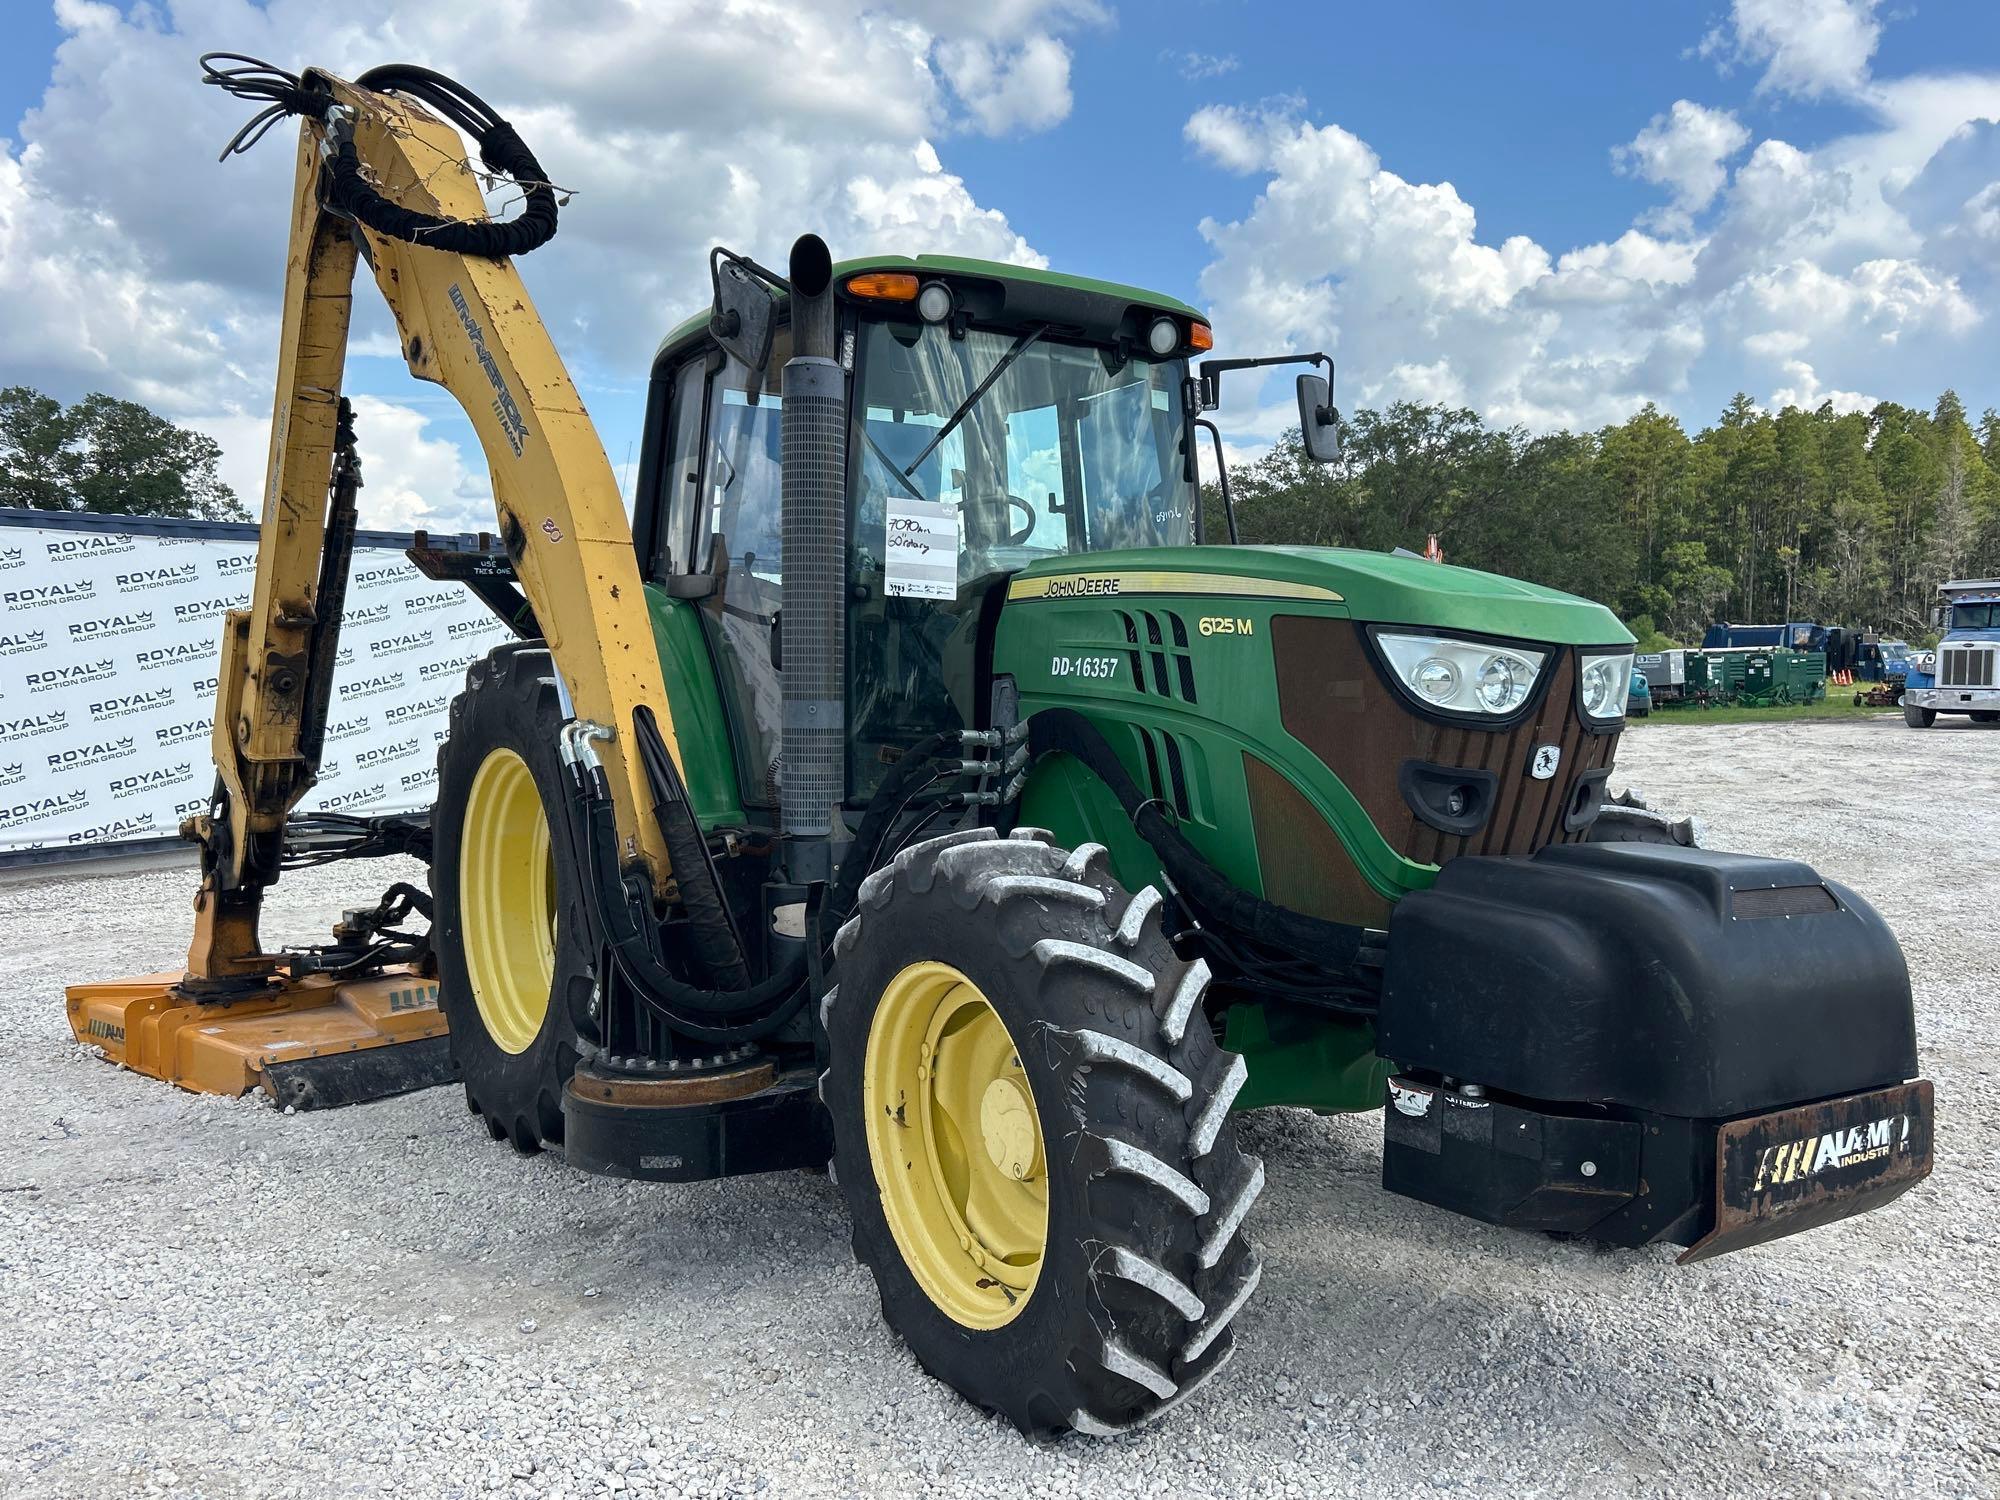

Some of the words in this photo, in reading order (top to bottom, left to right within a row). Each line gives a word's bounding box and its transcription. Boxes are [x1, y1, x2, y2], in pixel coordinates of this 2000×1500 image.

[448, 284, 529, 449] MAVERICK
[47, 536, 116, 554] ROYAL
[51, 551, 98, 562] AUCTION
[100, 545, 136, 556] GROUP
[217, 554, 258, 569] ROY
[116, 567, 181, 586] ROYAL
[120, 581, 164, 593] AUCTION
[166, 575, 199, 586] GROUP
[355, 567, 405, 583] ROYAL
[358, 580, 392, 590] AUCTION
[393, 573, 420, 583] GROUP
[4, 584, 76, 603] ROYAL
[1043, 579, 1076, 597] JOHN
[1076, 577, 1120, 596] DEERE
[8, 599, 57, 612] AUCTION
[59, 592, 97, 603] GROUP
[174, 597, 235, 616] ROYAL
[405, 592, 453, 609] ROYAL
[408, 604, 440, 615] AUCTION
[442, 599, 467, 608] GROUP
[68, 615, 137, 635] ROYAL
[178, 611, 219, 624] AUCTION
[363, 615, 391, 625] GROUP
[448, 617, 493, 634] ROYAL
[72, 630, 119, 643] AUCTION
[121, 623, 156, 635] GROUP
[450, 630, 482, 640] AUCTION
[482, 623, 503, 633] GROUP
[9, 642, 48, 655] GROUP
[370, 634, 420, 651] ROYAL
[373, 645, 407, 658] AUCTION
[408, 640, 434, 651] GROUP
[136, 643, 200, 663] ROYAL
[140, 658, 184, 671] AUCTION
[185, 650, 218, 662] GROUP
[26, 664, 97, 685] ROYAL
[419, 658, 467, 675] ROYAL
[422, 670, 455, 682] AUCTION
[1051, 656, 1119, 678] DD-16357
[30, 679, 78, 693] AUCTION
[80, 671, 117, 683] GROUP
[339, 676, 390, 695] ROYAL
[342, 689, 377, 702] AUCTION
[378, 682, 406, 693] GROUP
[89, 693, 156, 715] ROYAL
[93, 707, 139, 723] AUCTION
[140, 699, 176, 711] GROUP
[385, 700, 435, 719] ROYAL
[388, 713, 422, 726] AUCTION
[424, 705, 449, 716] GROUP
[31, 723, 70, 736] GROUP
[343, 726, 371, 738] GROUP
[160, 733, 202, 748] AUCTION
[47, 742, 117, 766] ROYAL
[51, 758, 99, 774] AUCTION
[100, 748, 137, 761] GROUP
[355, 743, 407, 763] ROYAL
[359, 756, 393, 770] AUCTION
[395, 748, 421, 760] GROUP
[109, 768, 175, 792] ROYAL
[401, 767, 440, 785] ROYA
[404, 777, 436, 791] AUCTION
[113, 783, 159, 799] AUCTION
[160, 773, 194, 787] GROUP
[0, 795, 69, 820] ROYAL
[174, 796, 213, 815] ROY
[319, 788, 372, 811] ROYAL
[359, 793, 387, 806] GROUP
[1, 811, 50, 829] AUCTION
[52, 801, 90, 816] GROUP
[68, 818, 137, 843] ROYAL
[117, 824, 156, 838] GROUP
